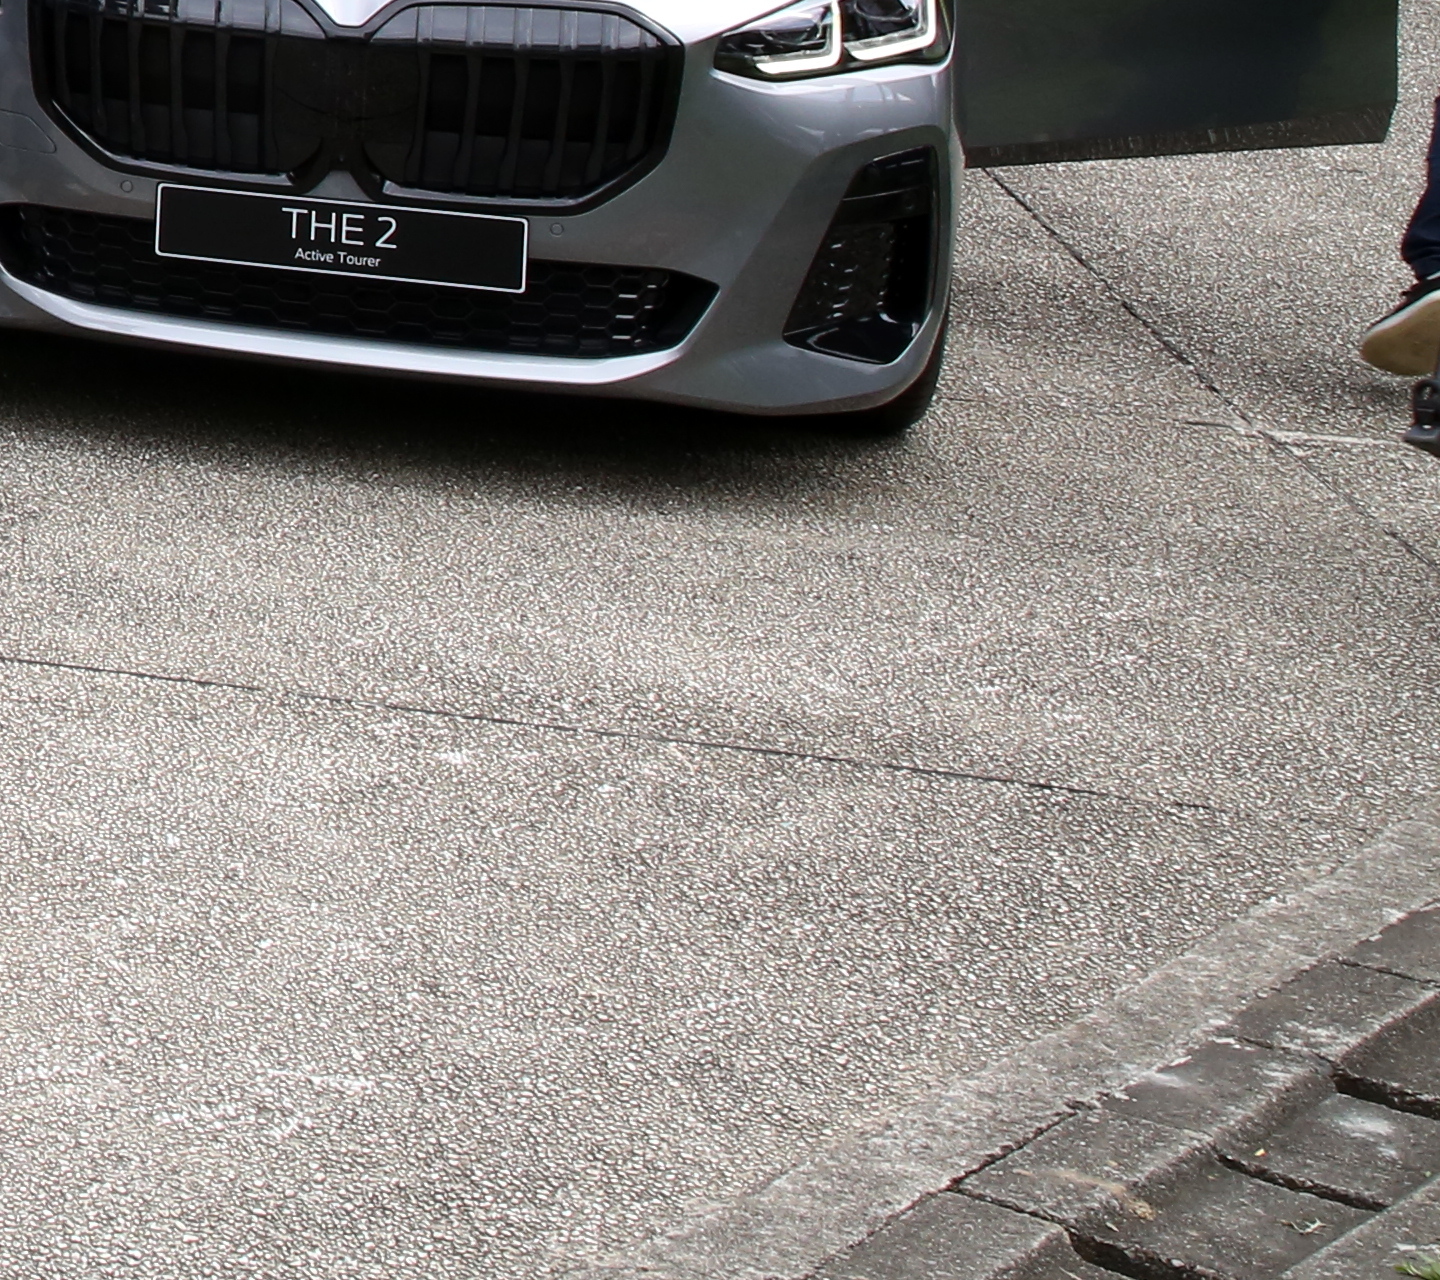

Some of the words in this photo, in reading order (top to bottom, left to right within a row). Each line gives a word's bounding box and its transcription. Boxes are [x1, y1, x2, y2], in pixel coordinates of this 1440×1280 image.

[281, 206, 365, 246] THE
[375, 216, 397, 249] 2
[294, 247, 334, 263] Active
[337, 251, 381, 268] Tourer
